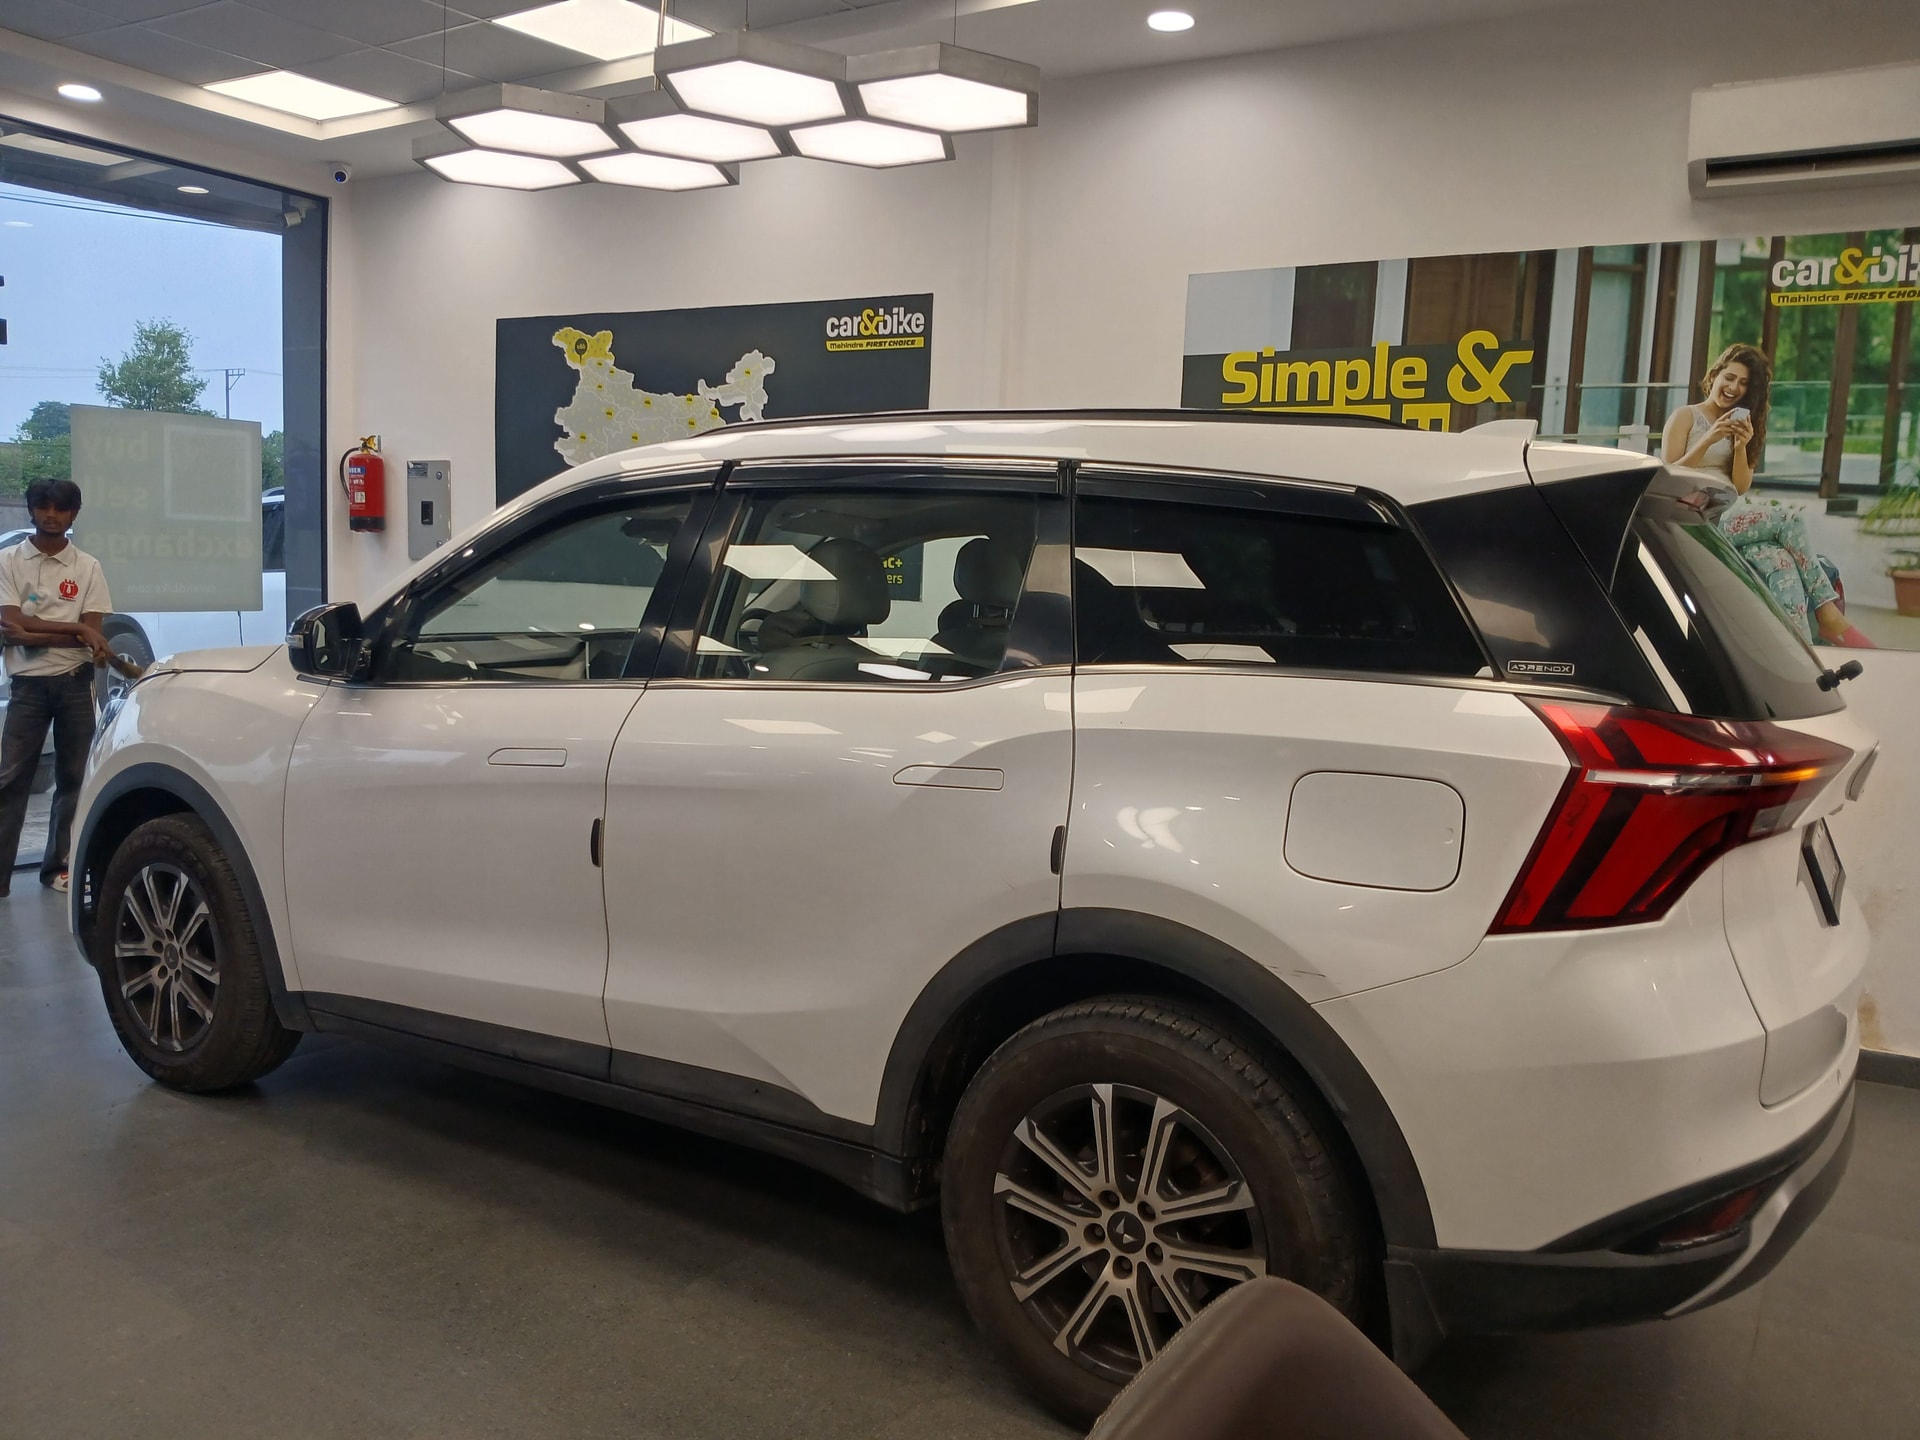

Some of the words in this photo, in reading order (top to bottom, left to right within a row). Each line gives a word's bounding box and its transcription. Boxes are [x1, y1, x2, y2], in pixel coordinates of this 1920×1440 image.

[1777, 293, 1840, 303] Mahindra
[1844, 291, 1887, 301] FIRST
[826, 307, 925, 337] car&bike
[829, 342, 864, 350] Mahindra
[865, 340, 888, 348] FIRST
[888, 339, 917, 347] CHOICE
[1222, 341, 1428, 407] Simple
[1446, 330, 1535, 404] &
[1511, 664, 1571, 672] ADRENOX
